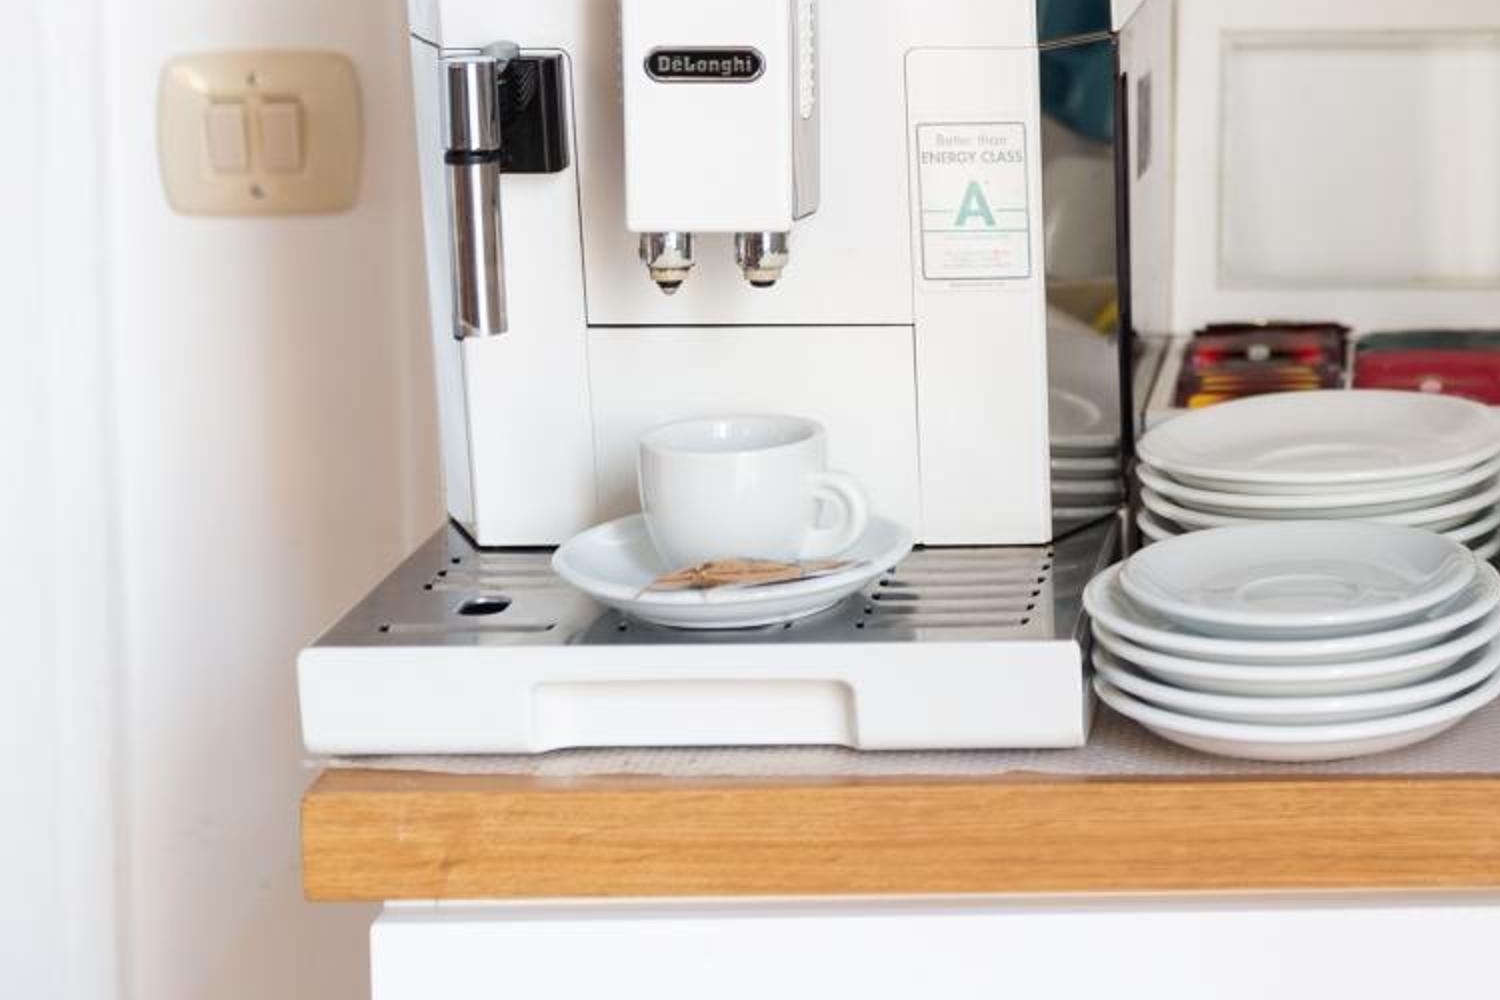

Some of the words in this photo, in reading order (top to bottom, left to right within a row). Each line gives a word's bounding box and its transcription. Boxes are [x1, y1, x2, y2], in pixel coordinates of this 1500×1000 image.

[921, 151, 977, 165] ENERGY
[980, 150, 1024, 164] CLASS
[954, 180, 997, 227] A
